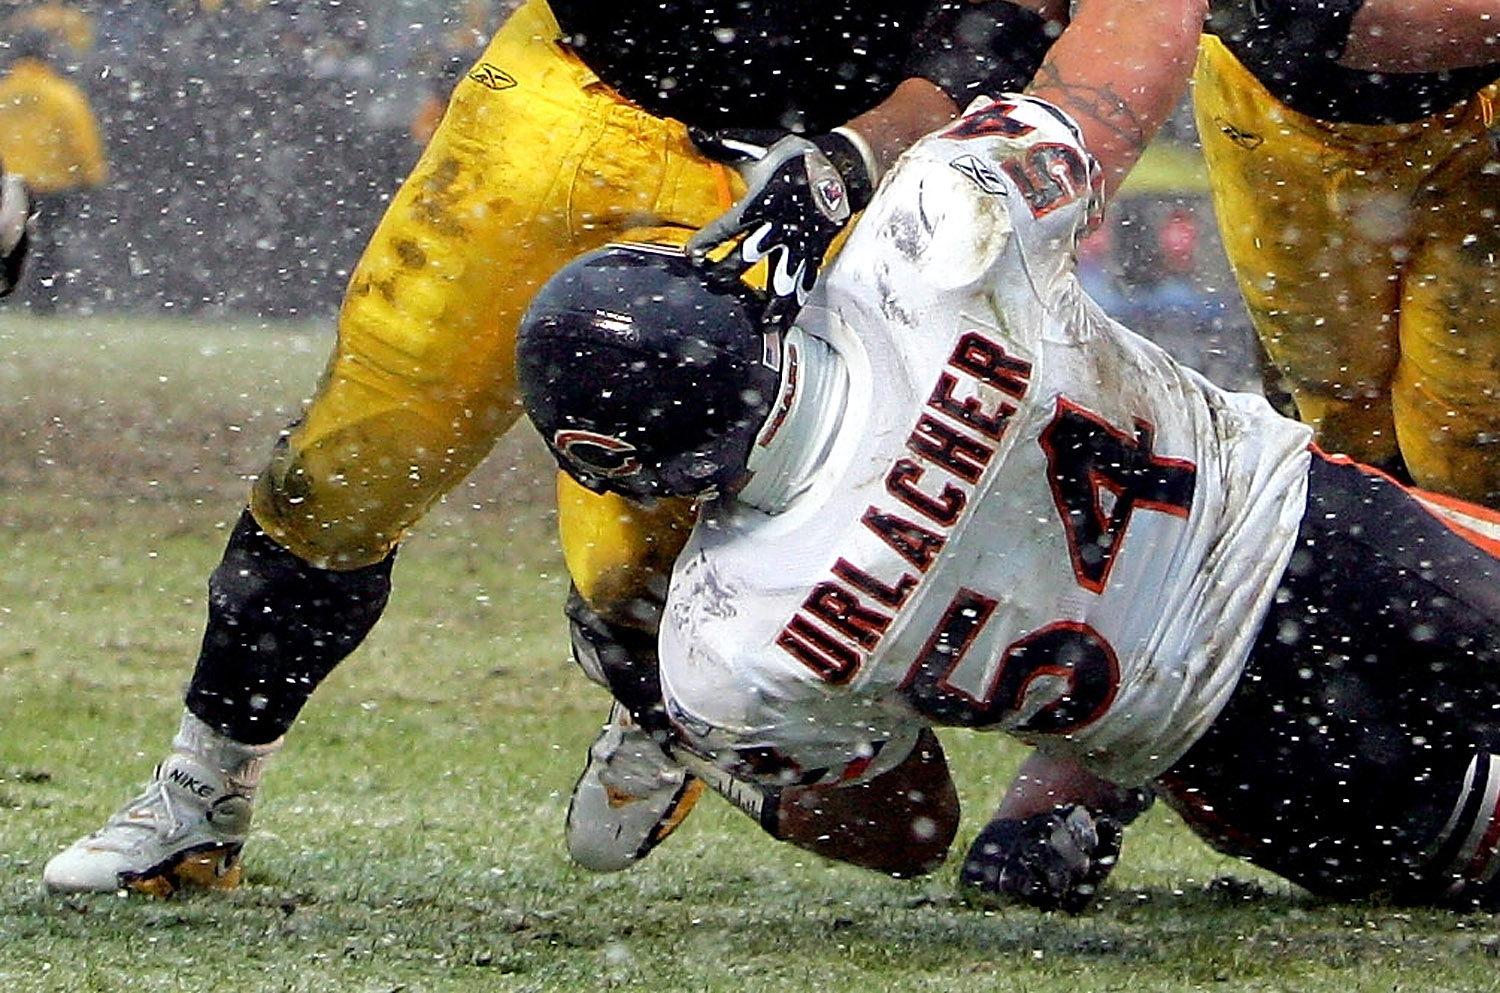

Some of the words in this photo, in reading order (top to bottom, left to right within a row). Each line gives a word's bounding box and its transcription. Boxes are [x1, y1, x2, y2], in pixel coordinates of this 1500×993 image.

[775, 331, 1034, 685] URLACHER
[902, 393, 1198, 735] 54
[169, 769, 216, 798] NIKE
